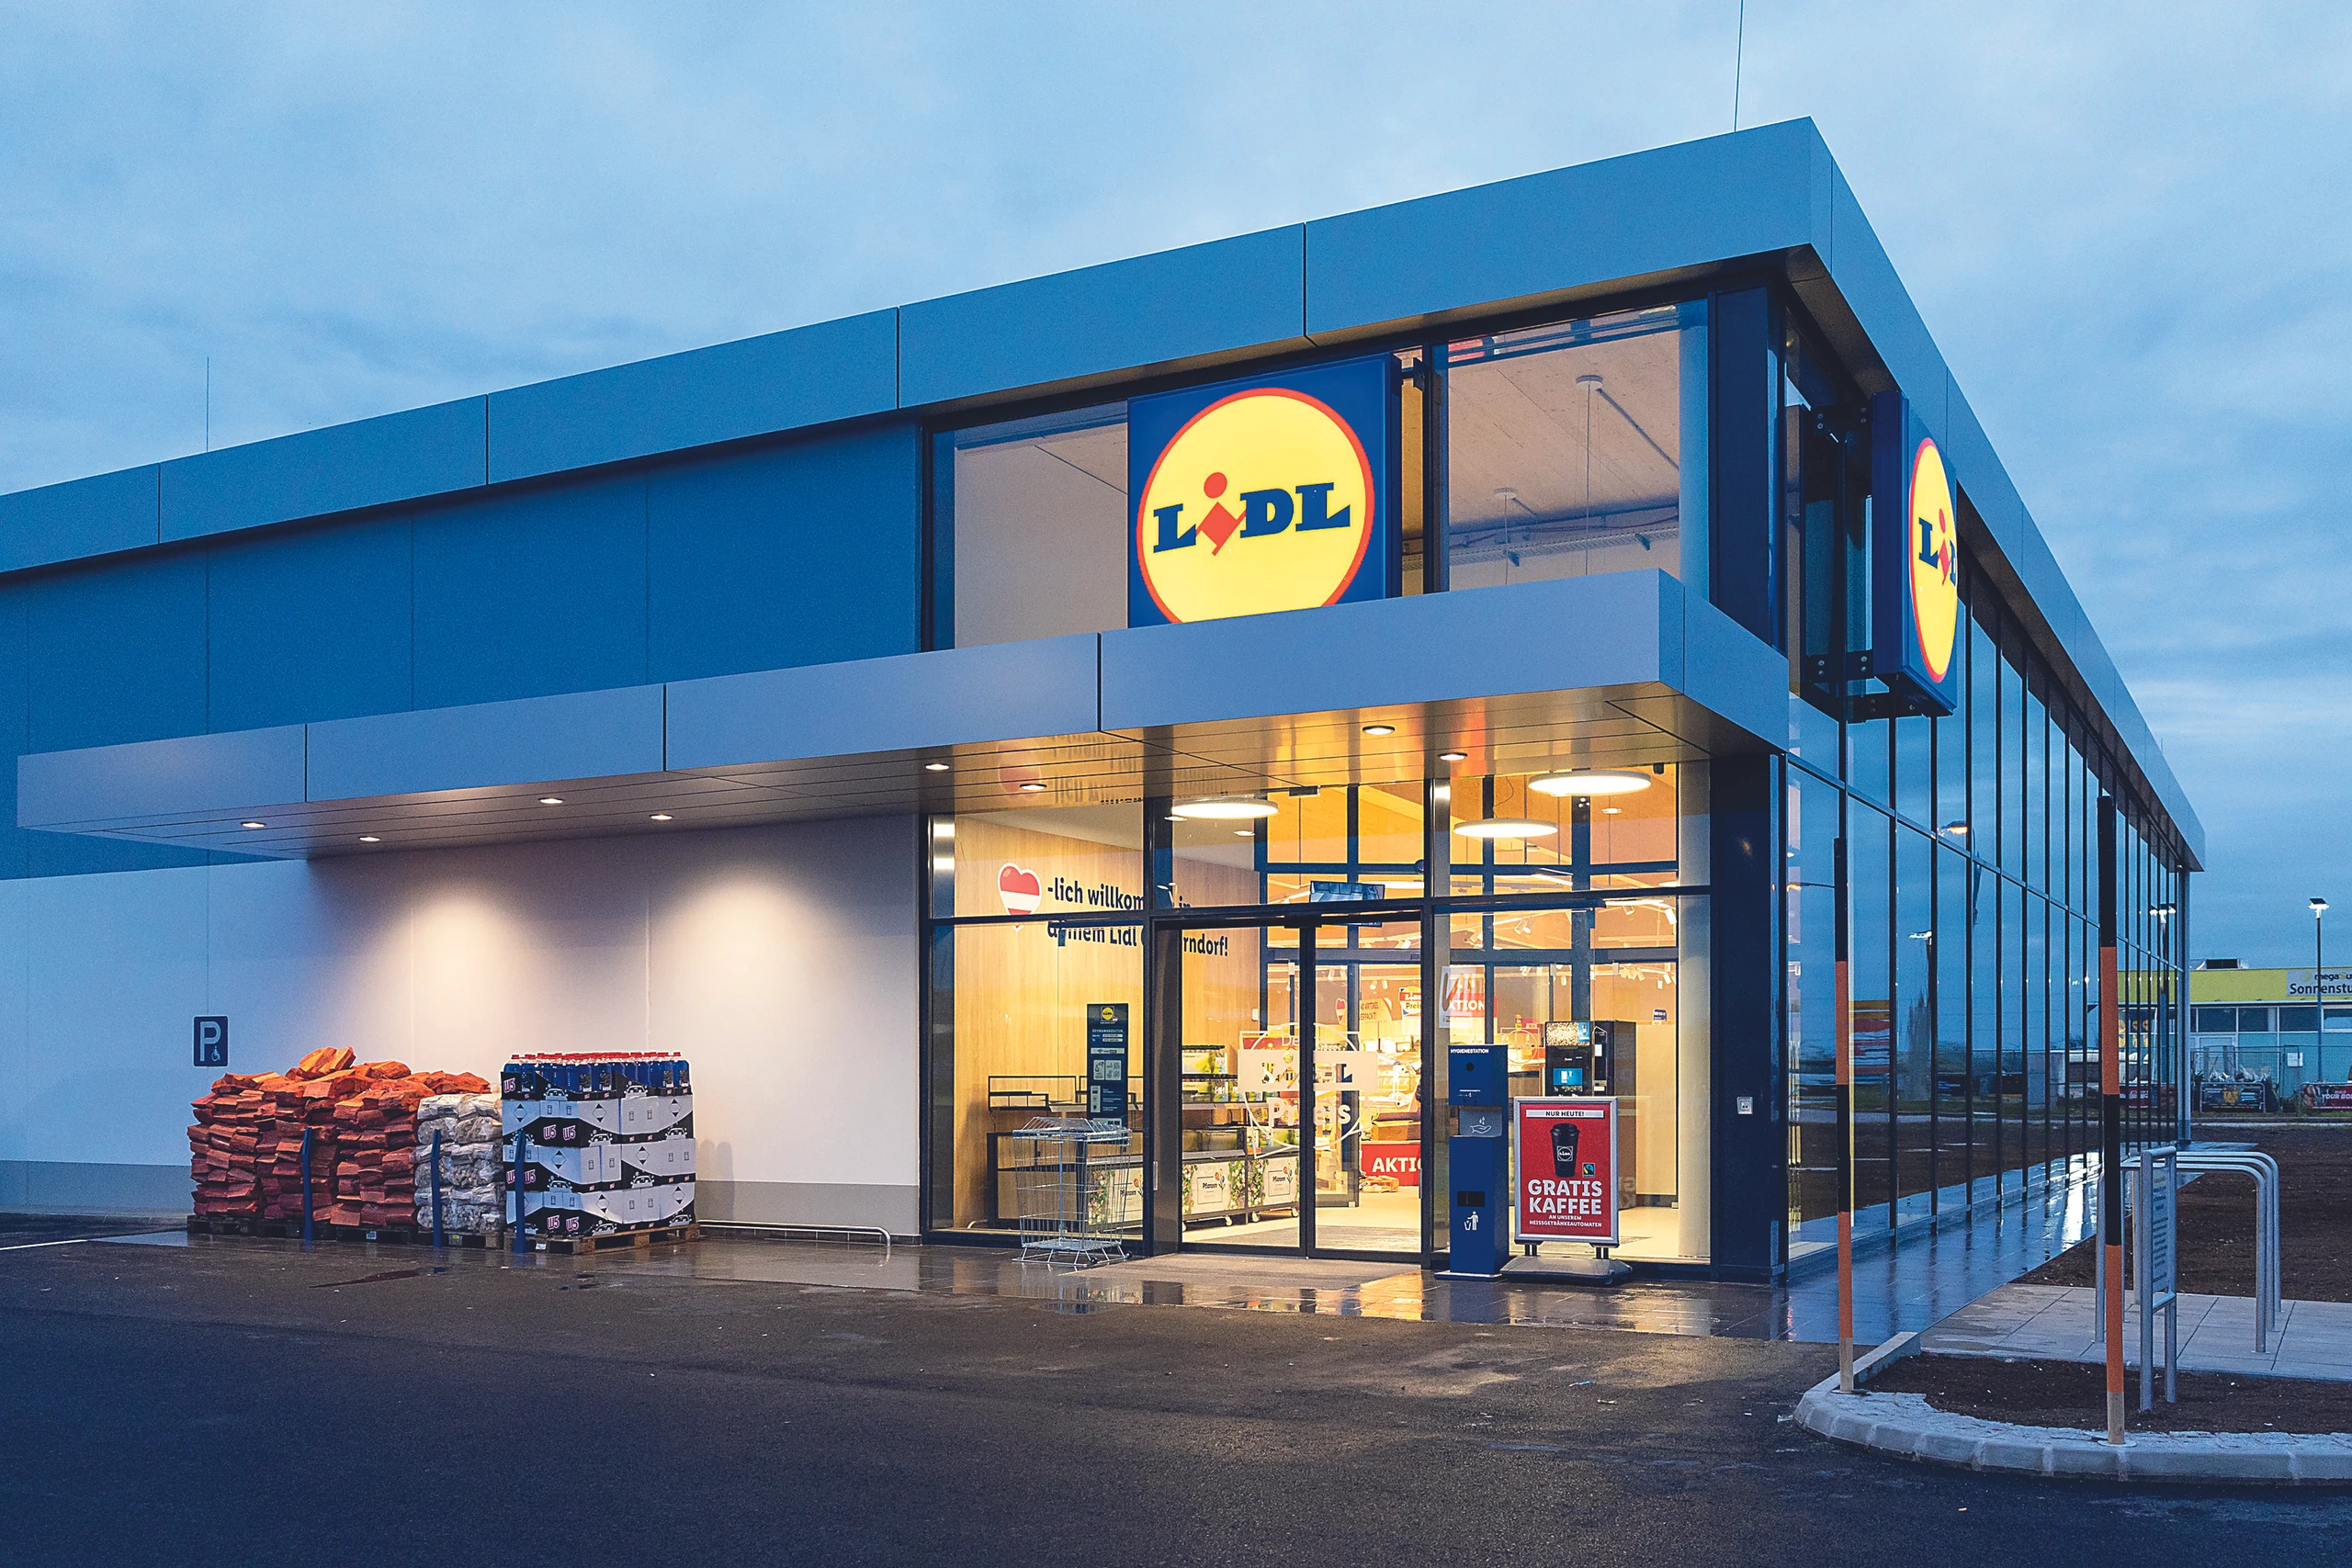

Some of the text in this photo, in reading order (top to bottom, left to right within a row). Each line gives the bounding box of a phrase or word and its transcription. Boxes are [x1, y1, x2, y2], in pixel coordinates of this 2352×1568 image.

[1087, 883, 1144, 910] willkom
[1110, 926, 1137, 946] Lidl
[1450, 998, 1485, 1011] KTION
[199, 1021, 221, 1062] P
[1372, 1156, 1421, 1173] AKTI
[1528, 1179, 1602, 1197] GRATIS
[1529, 1197, 1602, 1215] KAFFEE
